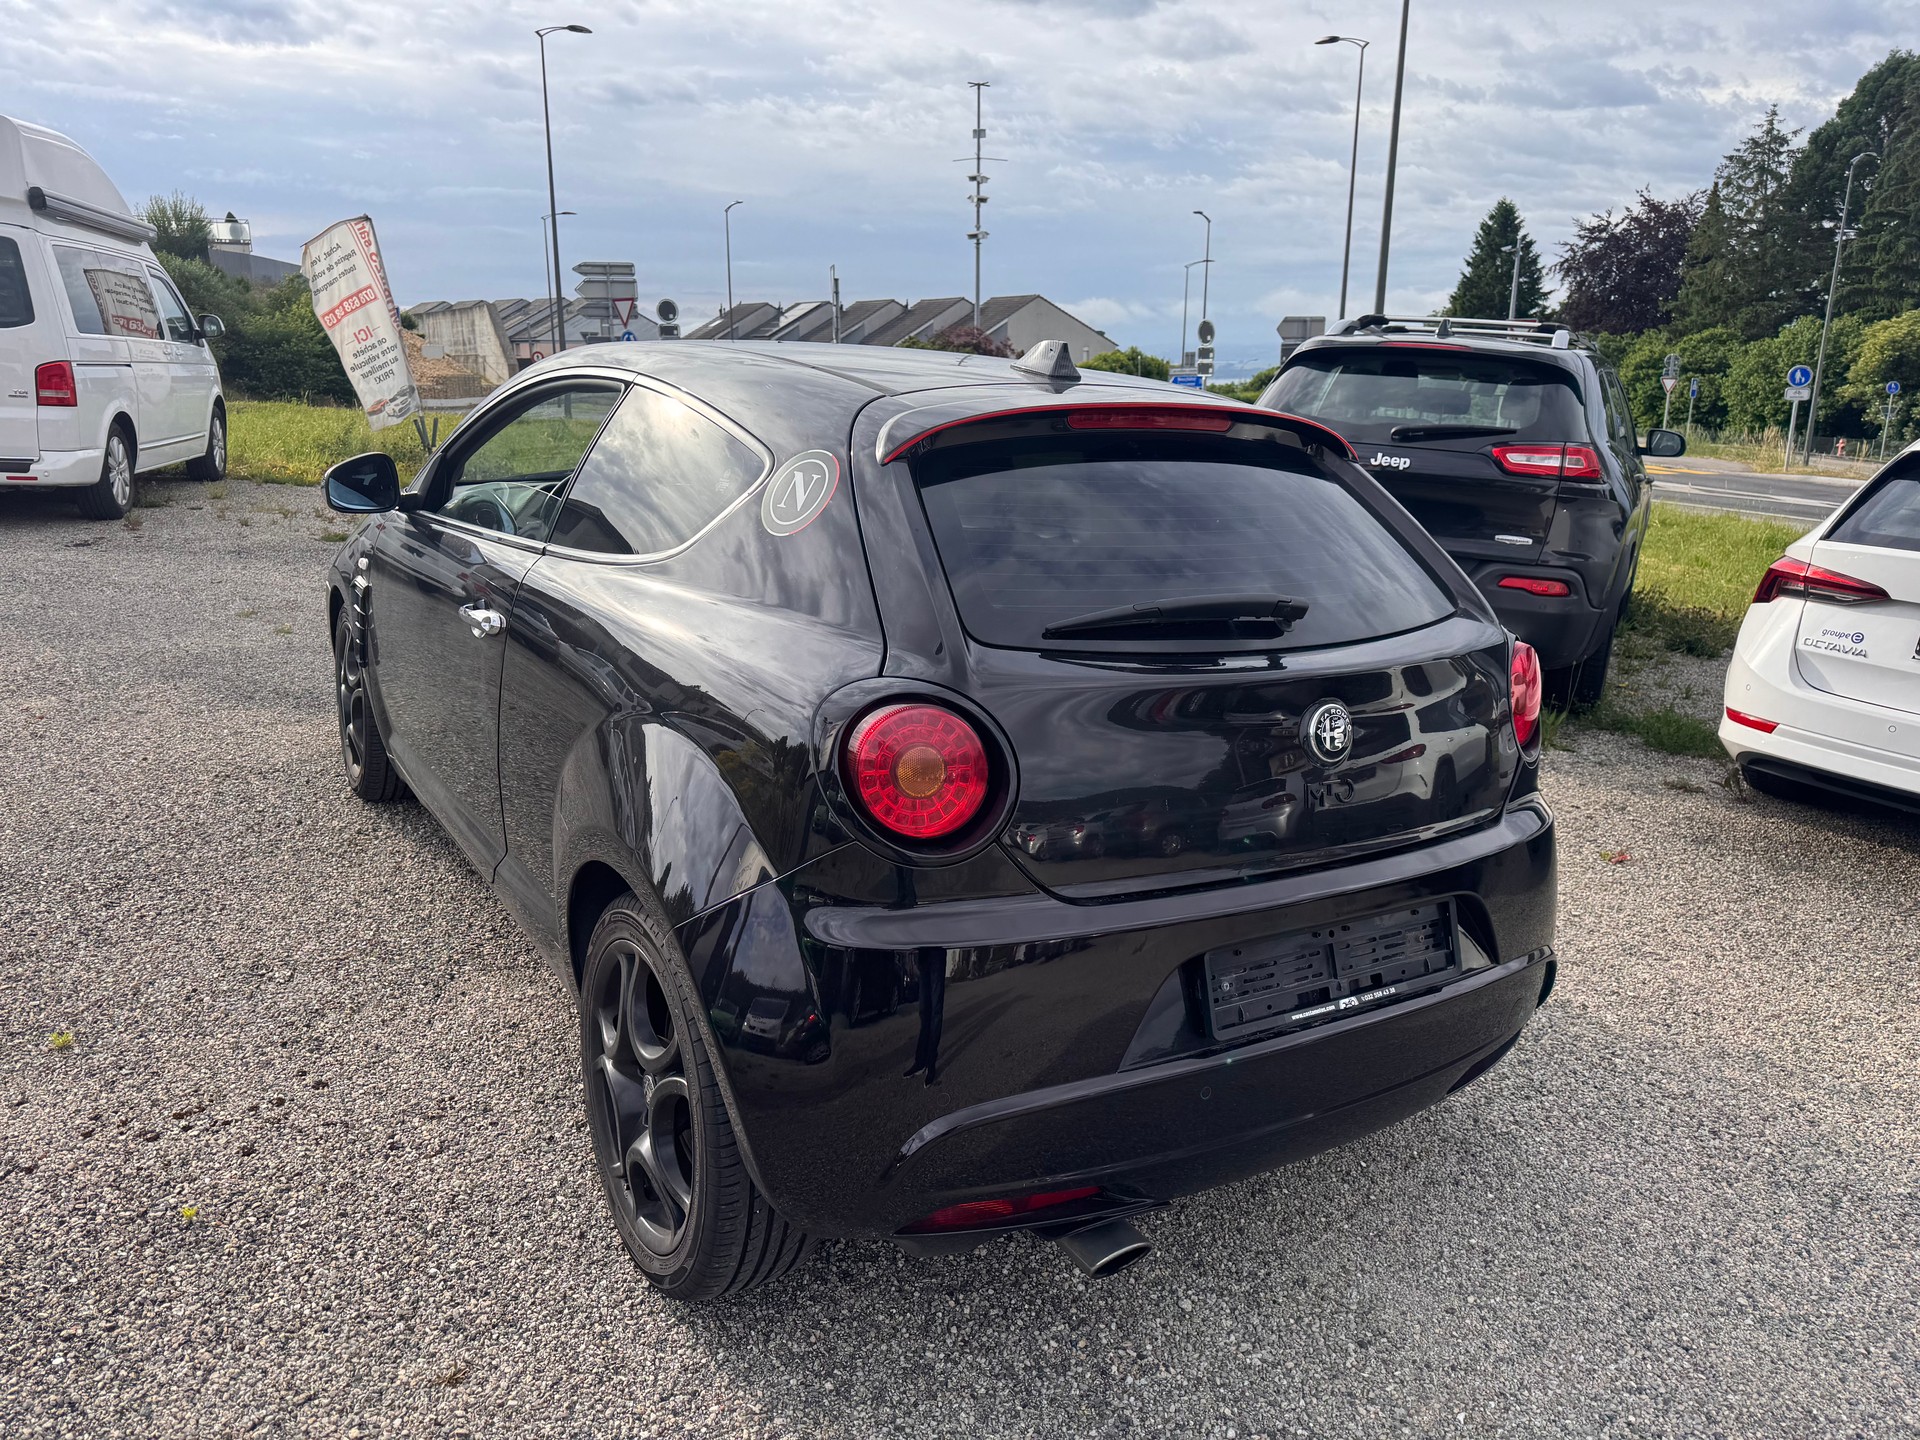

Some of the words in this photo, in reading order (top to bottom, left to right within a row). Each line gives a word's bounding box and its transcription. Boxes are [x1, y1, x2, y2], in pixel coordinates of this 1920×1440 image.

[1370, 452, 1410, 470] Jeep
[777, 471, 821, 511] N
[1822, 629, 1851, 639] groupe
[1804, 638, 1868, 658] OCTAVIA
[1316, 712, 1330, 735] ALFA
[1330, 708, 1352, 731] ROMEO
